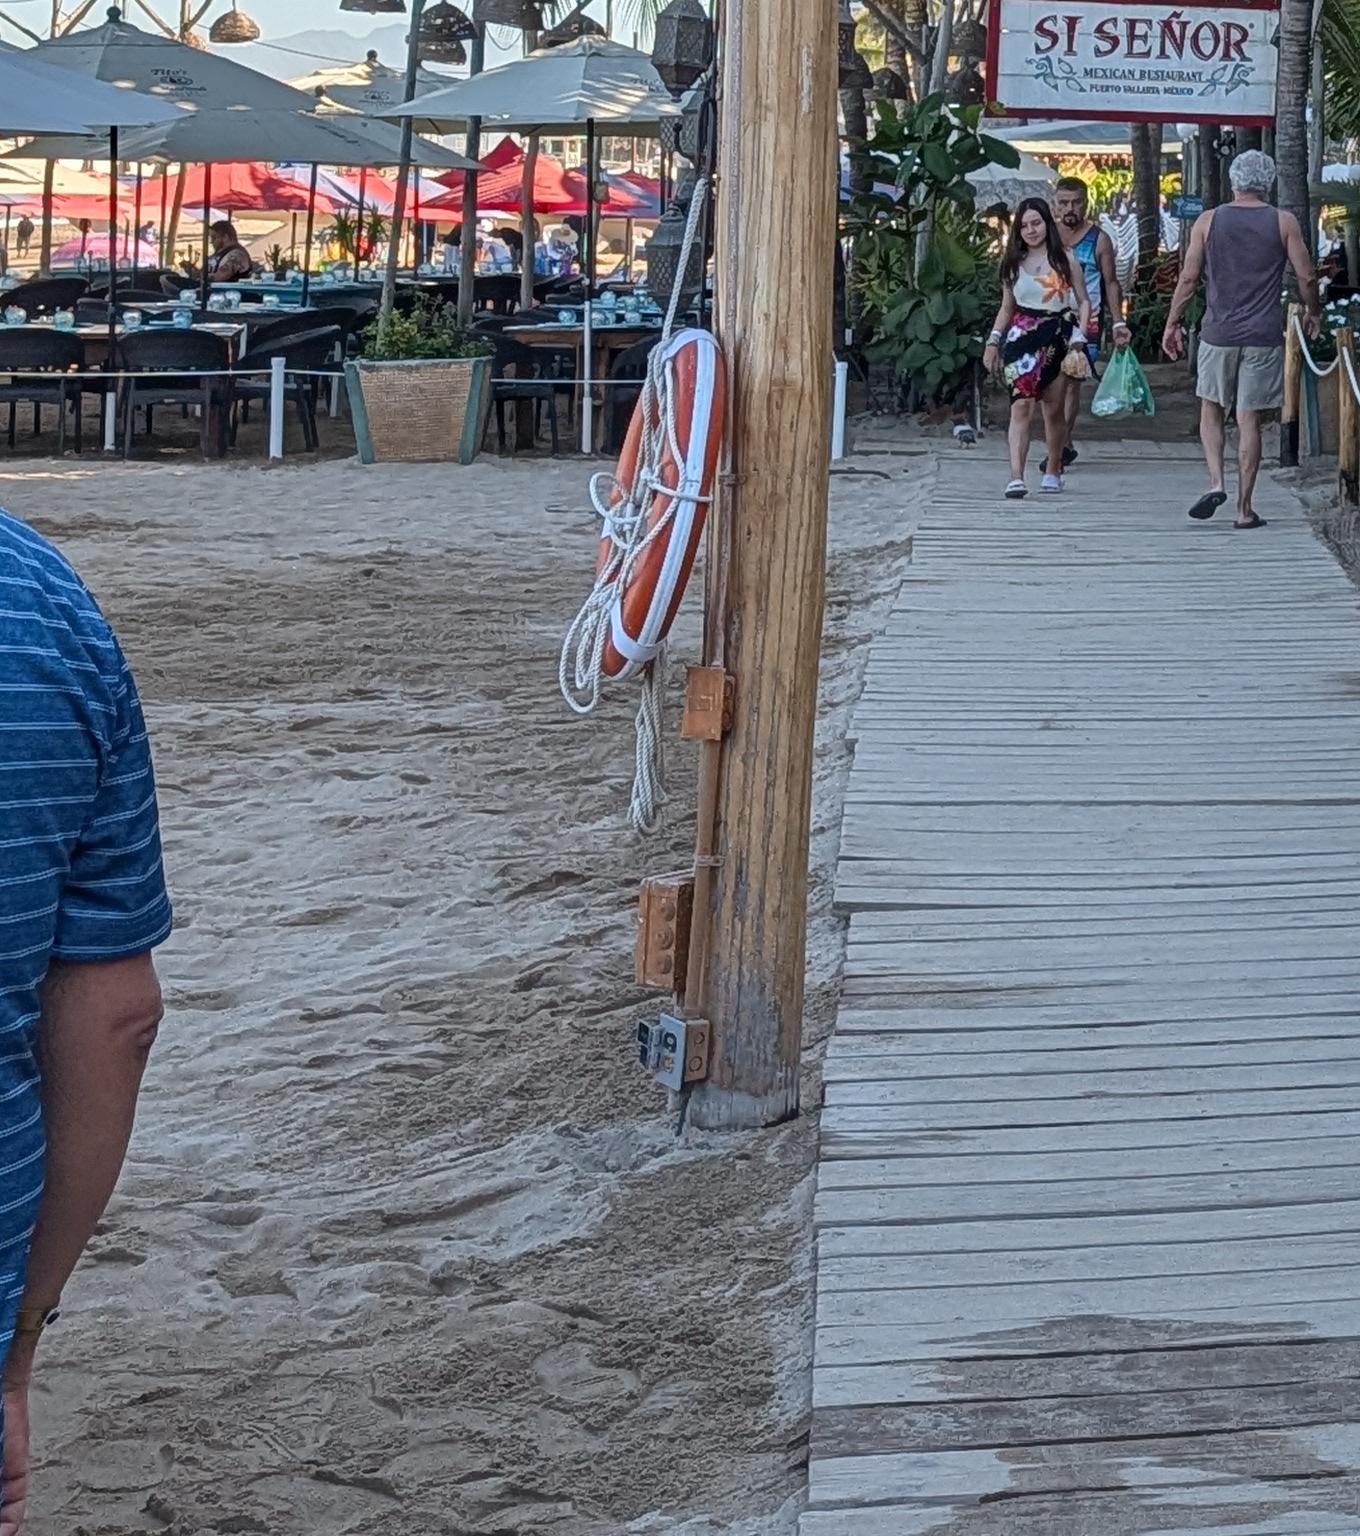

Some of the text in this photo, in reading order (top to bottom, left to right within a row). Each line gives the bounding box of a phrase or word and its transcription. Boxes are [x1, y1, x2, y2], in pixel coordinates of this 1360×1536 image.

[1034, 10, 1253, 63] SI SEÑOR
[1083, 67, 1204, 83] MEXICAN RESTAURANT
[1089, 83, 1121, 94] PUERTO
[1123, 85, 1160, 95] VALLARTA
